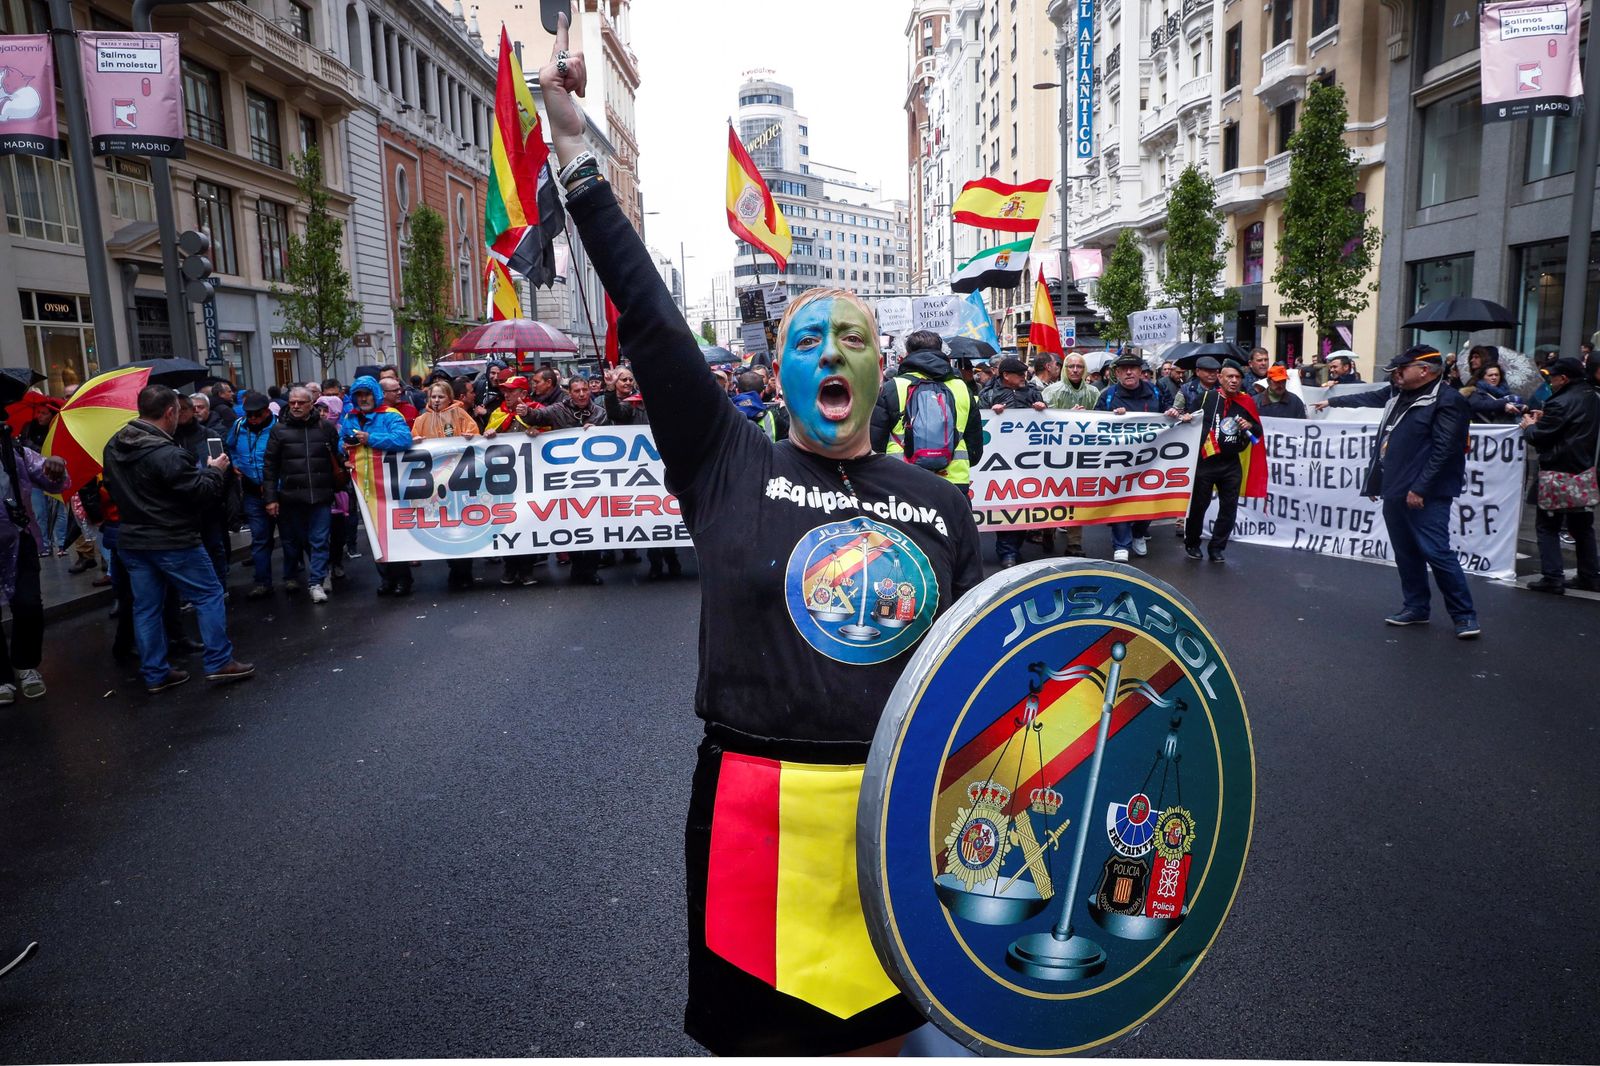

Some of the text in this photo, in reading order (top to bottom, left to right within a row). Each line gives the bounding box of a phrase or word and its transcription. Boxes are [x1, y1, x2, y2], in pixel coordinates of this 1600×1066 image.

[1504, 17, 1543, 26] Salimos
[1504, 24, 1564, 35] sin molestar
[100, 51, 137, 59] Salimos
[1079, 27, 1091, 155] ATLANTICO
[1535, 102, 1570, 112] MADRID
[3, 140, 45, 150] MADRID
[131, 142, 171, 152] MADRID
[44, 303, 70, 313] OYSHO
[923, 301, 948, 309] PAGAS
[920, 311, 954, 319] MISERAS
[1143, 314, 1168, 322] PAGAS
[1139, 323, 1172, 331] MISERAS
[1075, 421, 1093, 433] Y
[1028, 431, 1158, 447] SIN DESTINO
[979, 442, 1190, 472] ACUERDO
[382, 442, 534, 501] 13.481
[543, 463, 662, 492] ESTÁ
[985, 467, 1190, 501] MOMENTOS
[391, 494, 682, 530] ELLOS VIVIERO
[1306, 502, 1376, 534] VOTOS
[532, 528, 594, 548] LOS
[604, 520, 691, 543] HABÉ
[1002, 585, 1219, 700] JUSAPOL
